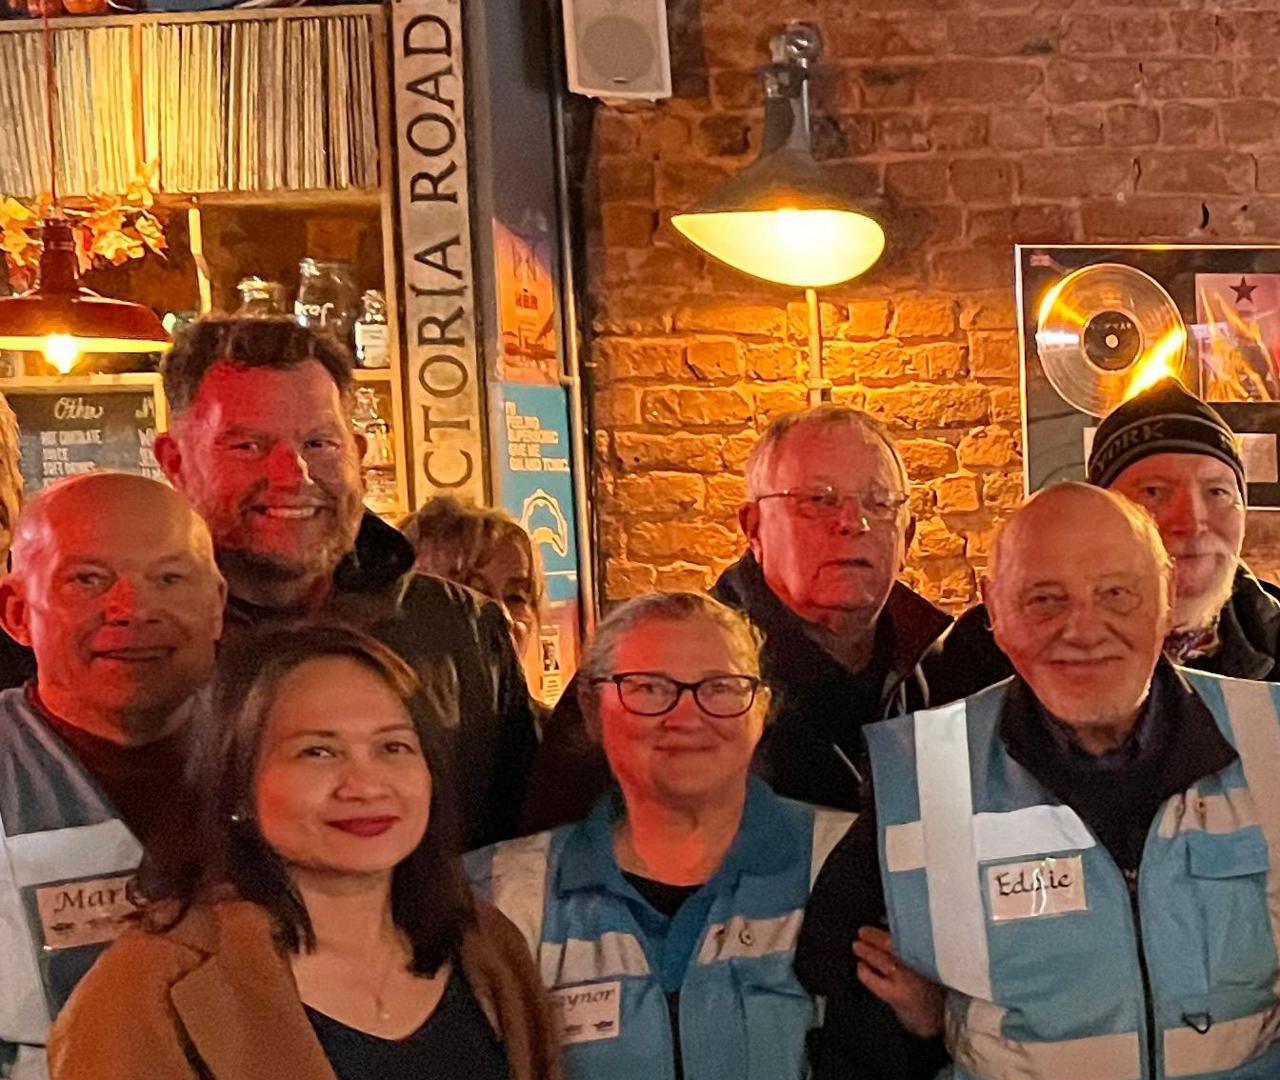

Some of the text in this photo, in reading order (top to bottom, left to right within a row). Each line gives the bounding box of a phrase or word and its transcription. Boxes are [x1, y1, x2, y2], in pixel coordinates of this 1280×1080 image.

[403, 14, 473, 489] CTORIA ROAD
[995, 869, 1073, 896] Eddie
[53, 888, 124, 914] Mar
[565, 988, 616, 1012] ynor
